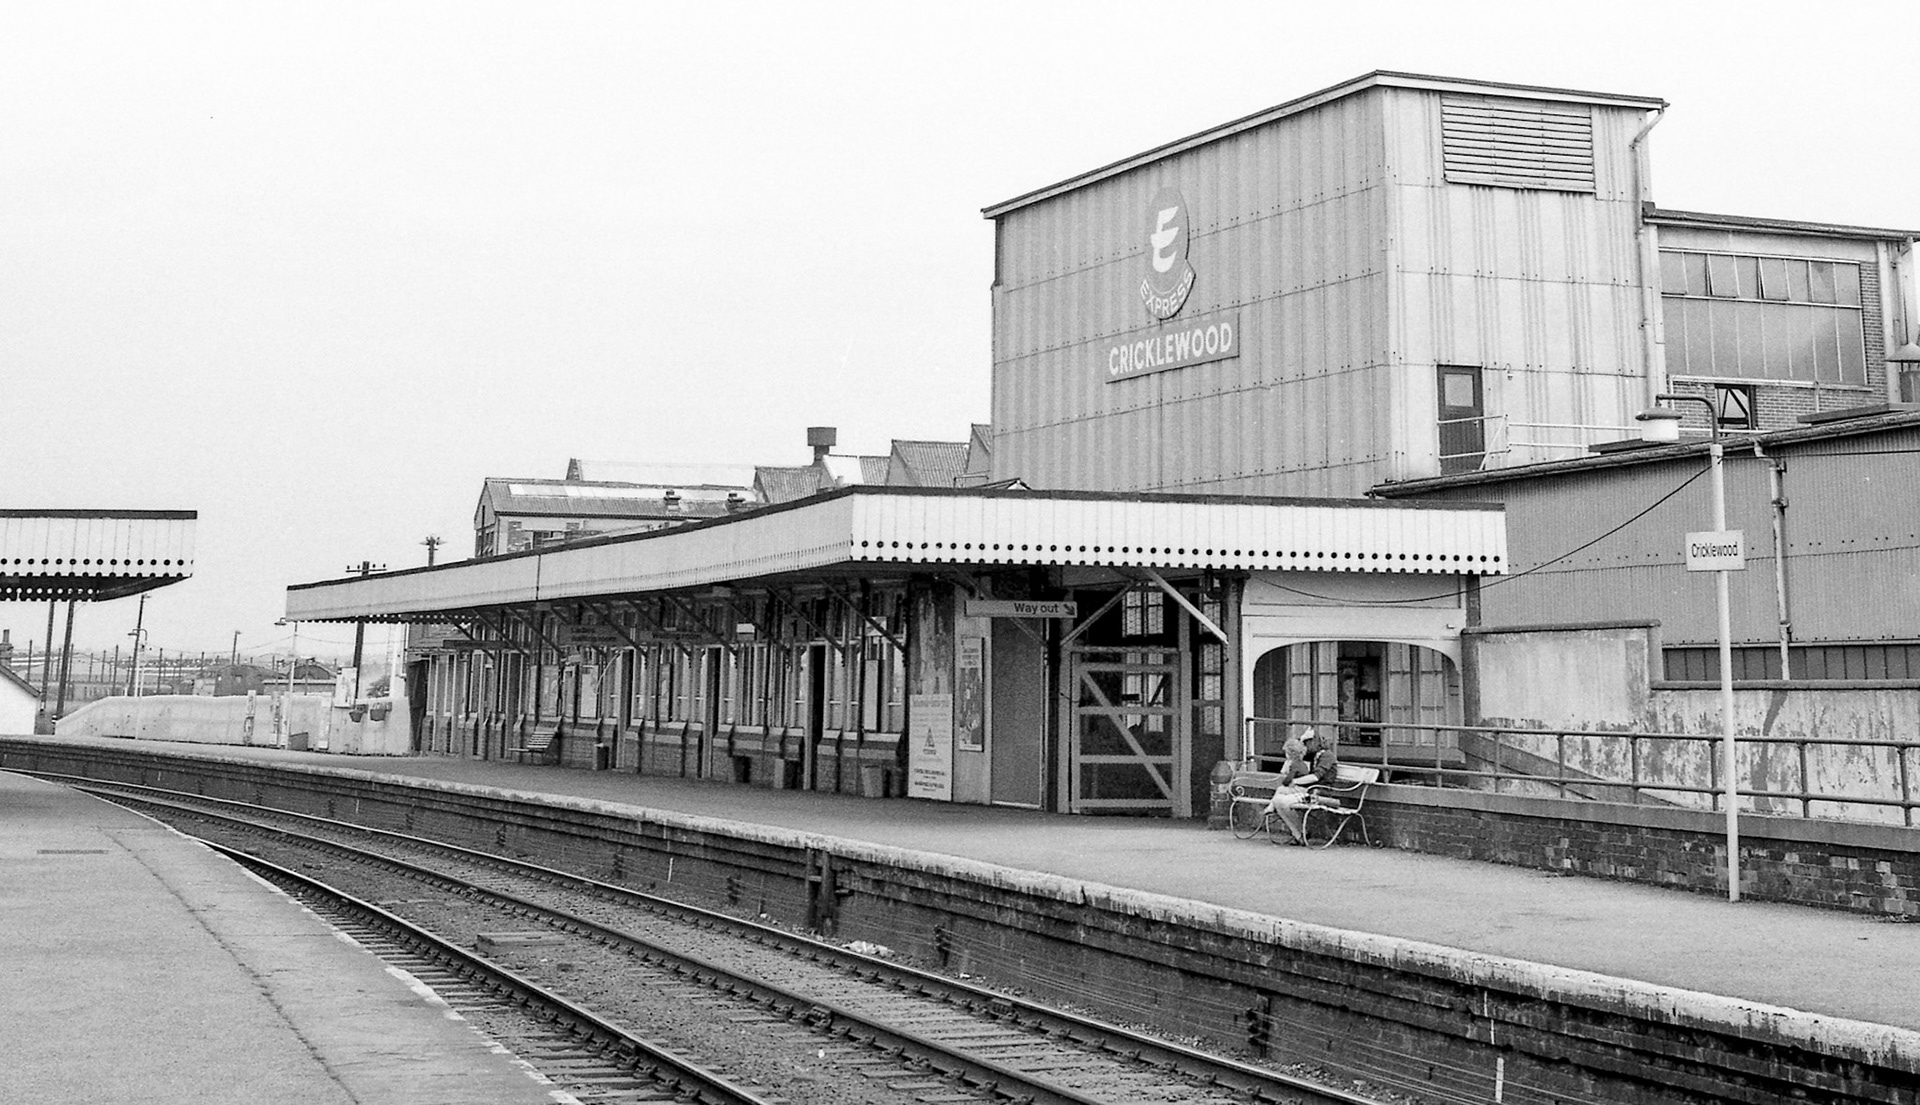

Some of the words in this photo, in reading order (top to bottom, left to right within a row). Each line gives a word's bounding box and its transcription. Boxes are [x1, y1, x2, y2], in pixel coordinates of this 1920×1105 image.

[1140, 268, 1194, 317] EXPRESS
[1109, 322, 1233, 376] CRICKLEWOOD
[1691, 542, 1738, 558] Cricklewood
[1013, 602, 1038, 615] Way
[1040, 603, 1059, 613] out
